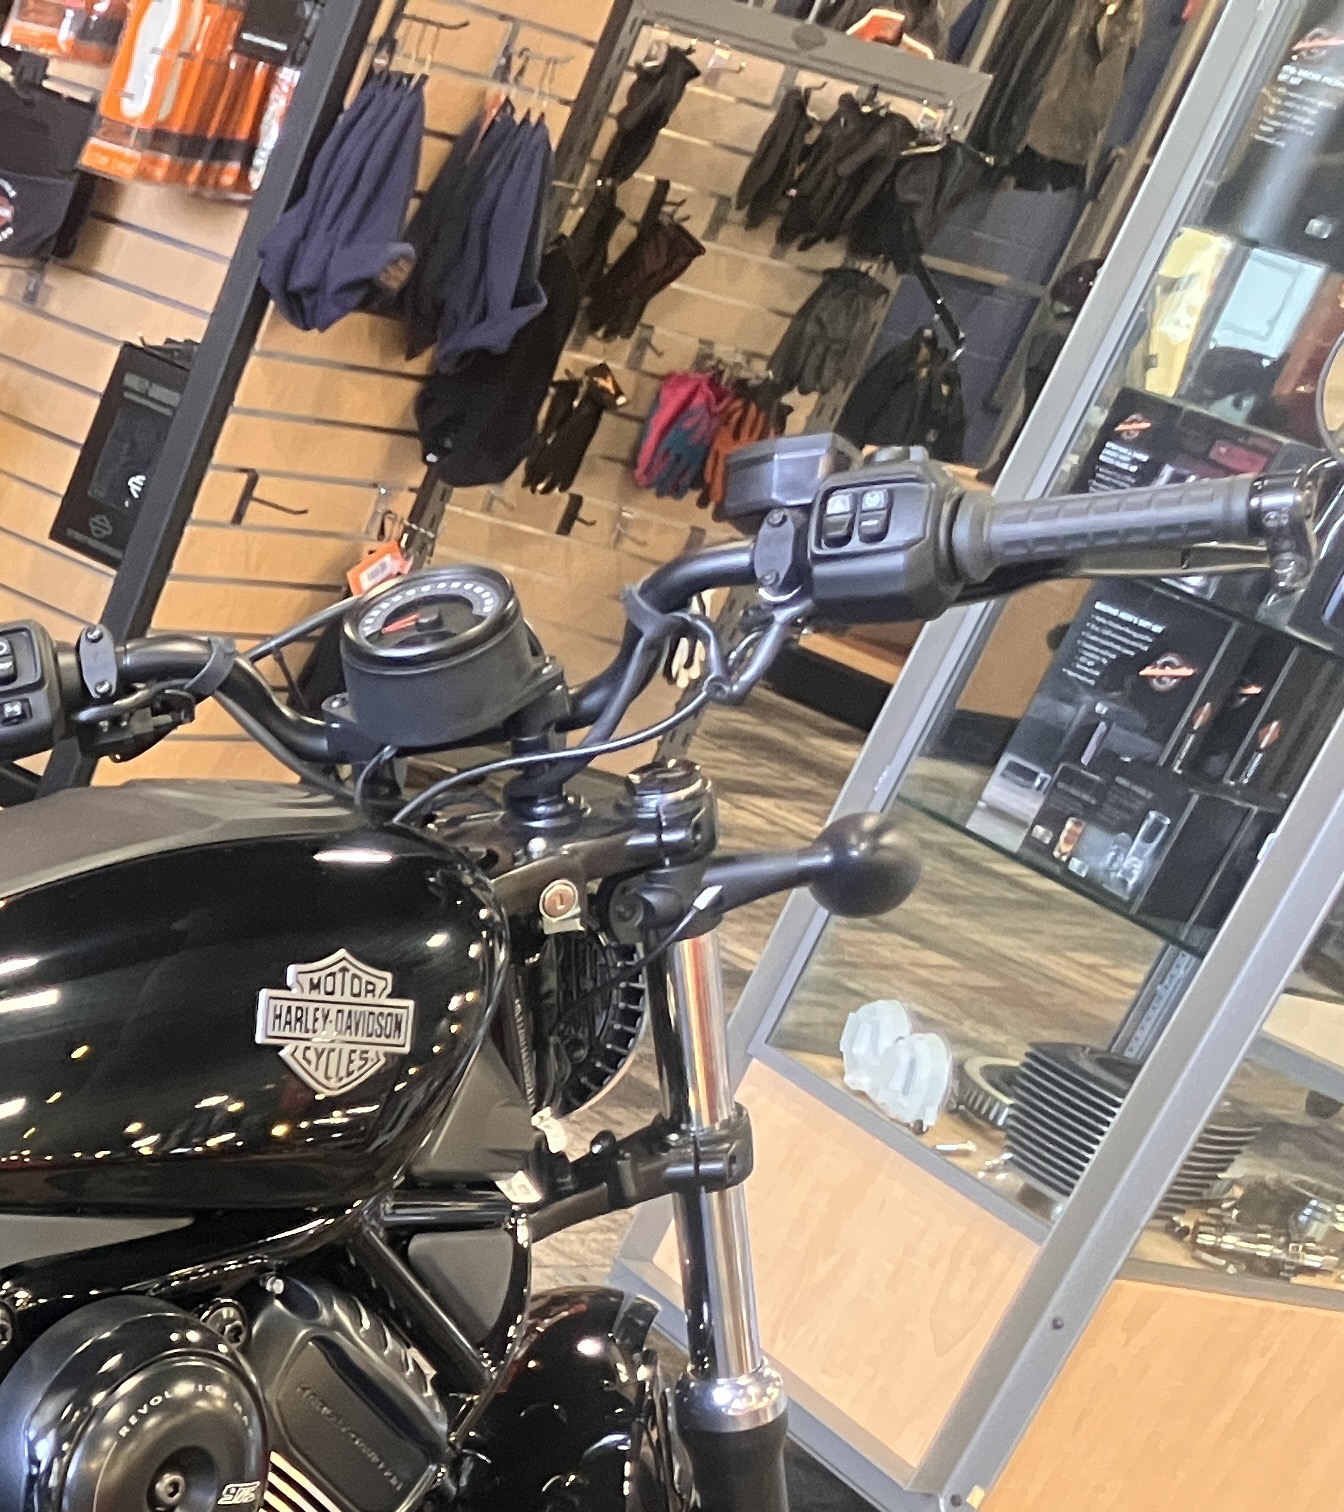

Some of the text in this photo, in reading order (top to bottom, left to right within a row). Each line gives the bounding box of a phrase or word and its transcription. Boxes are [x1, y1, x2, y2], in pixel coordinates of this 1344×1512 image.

[308, 965, 378, 999] MOTOR
[271, 1003, 405, 1041] HARLEY-DAVIDSON
[301, 1044, 372, 1082] CYCLES
